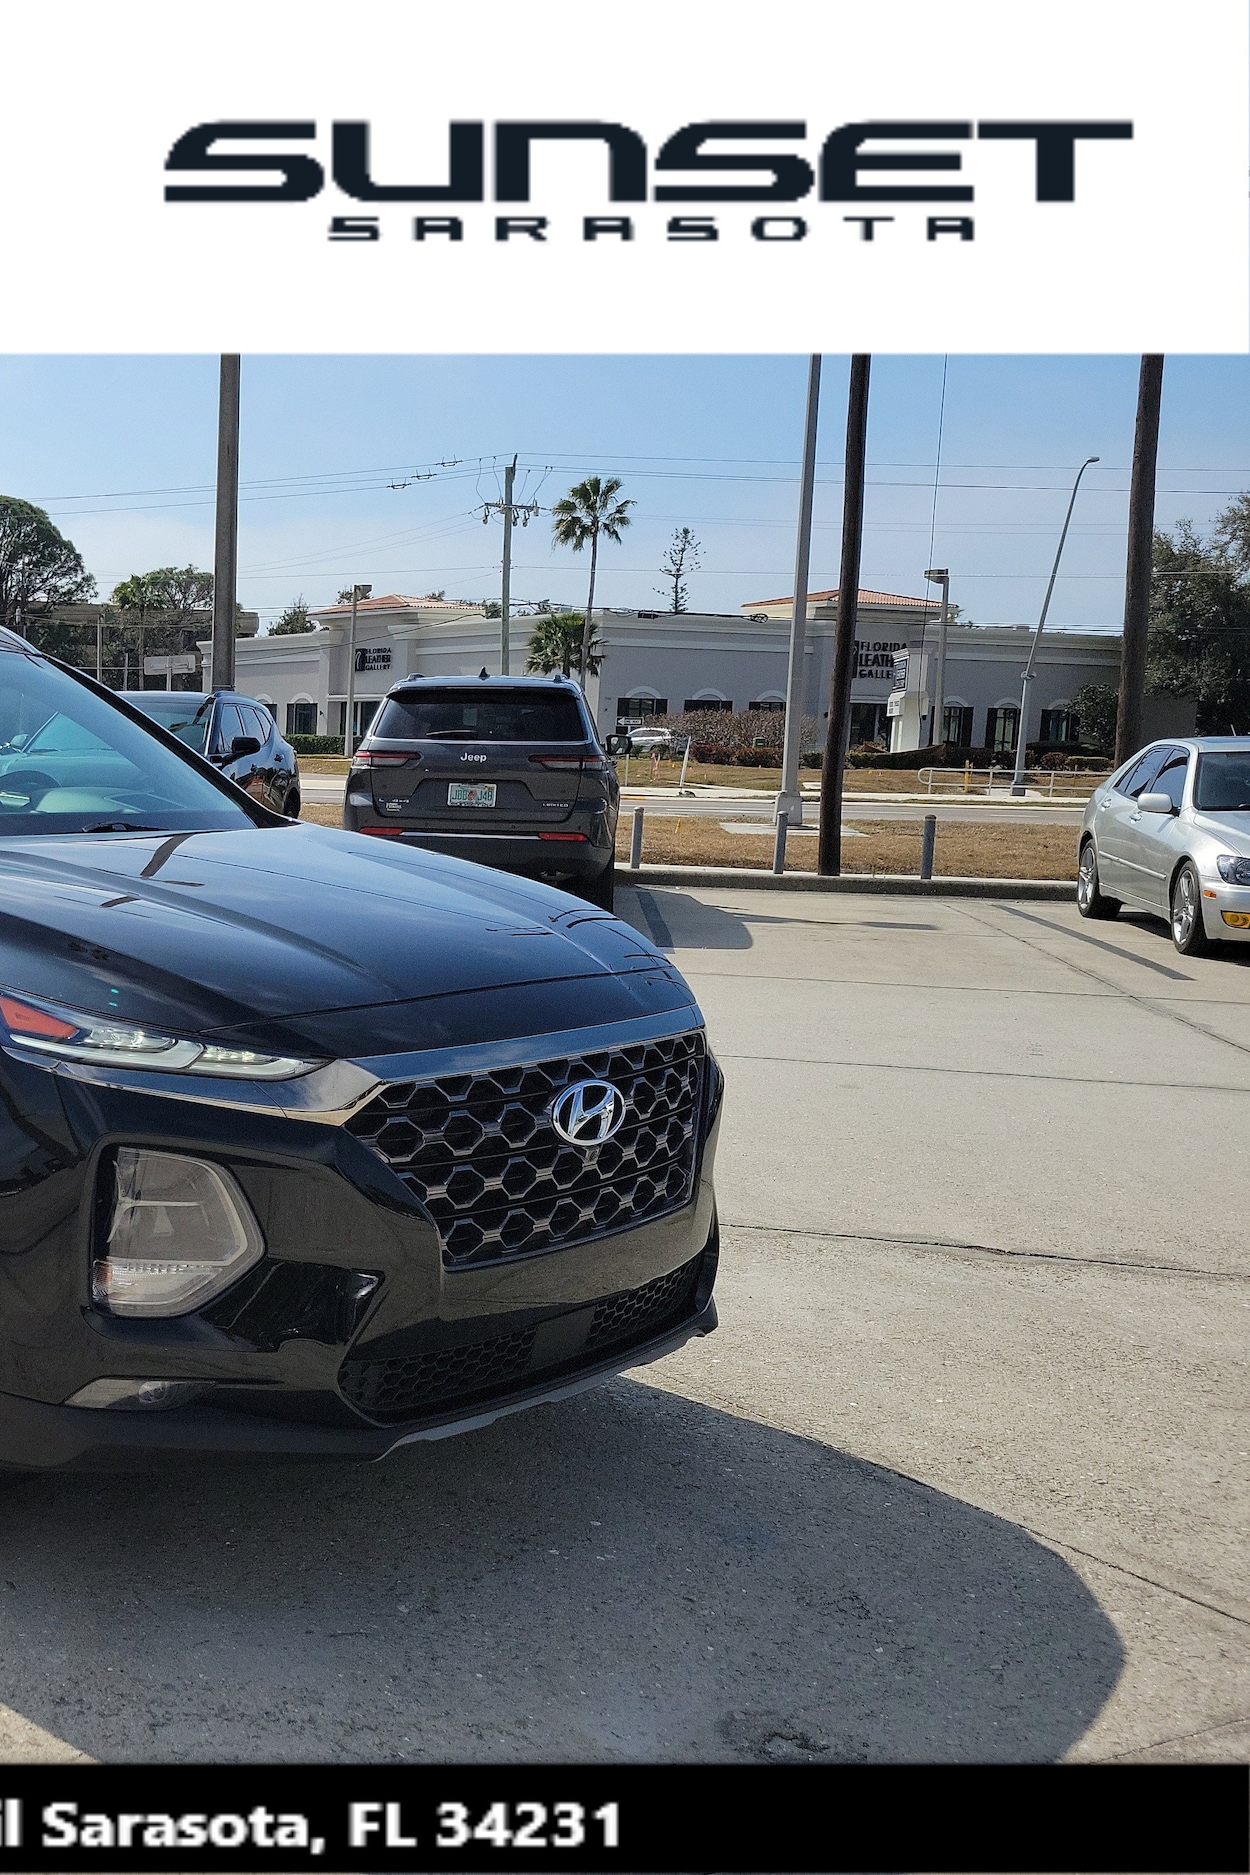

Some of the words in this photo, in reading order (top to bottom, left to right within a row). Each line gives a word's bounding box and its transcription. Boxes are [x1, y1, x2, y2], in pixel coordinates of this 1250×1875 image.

[860, 641, 908, 652] FLORIDA
[859, 653, 894, 667] LEATH
[859, 669, 894, 679] GALLE
[460, 752, 487, 763] Jeep
